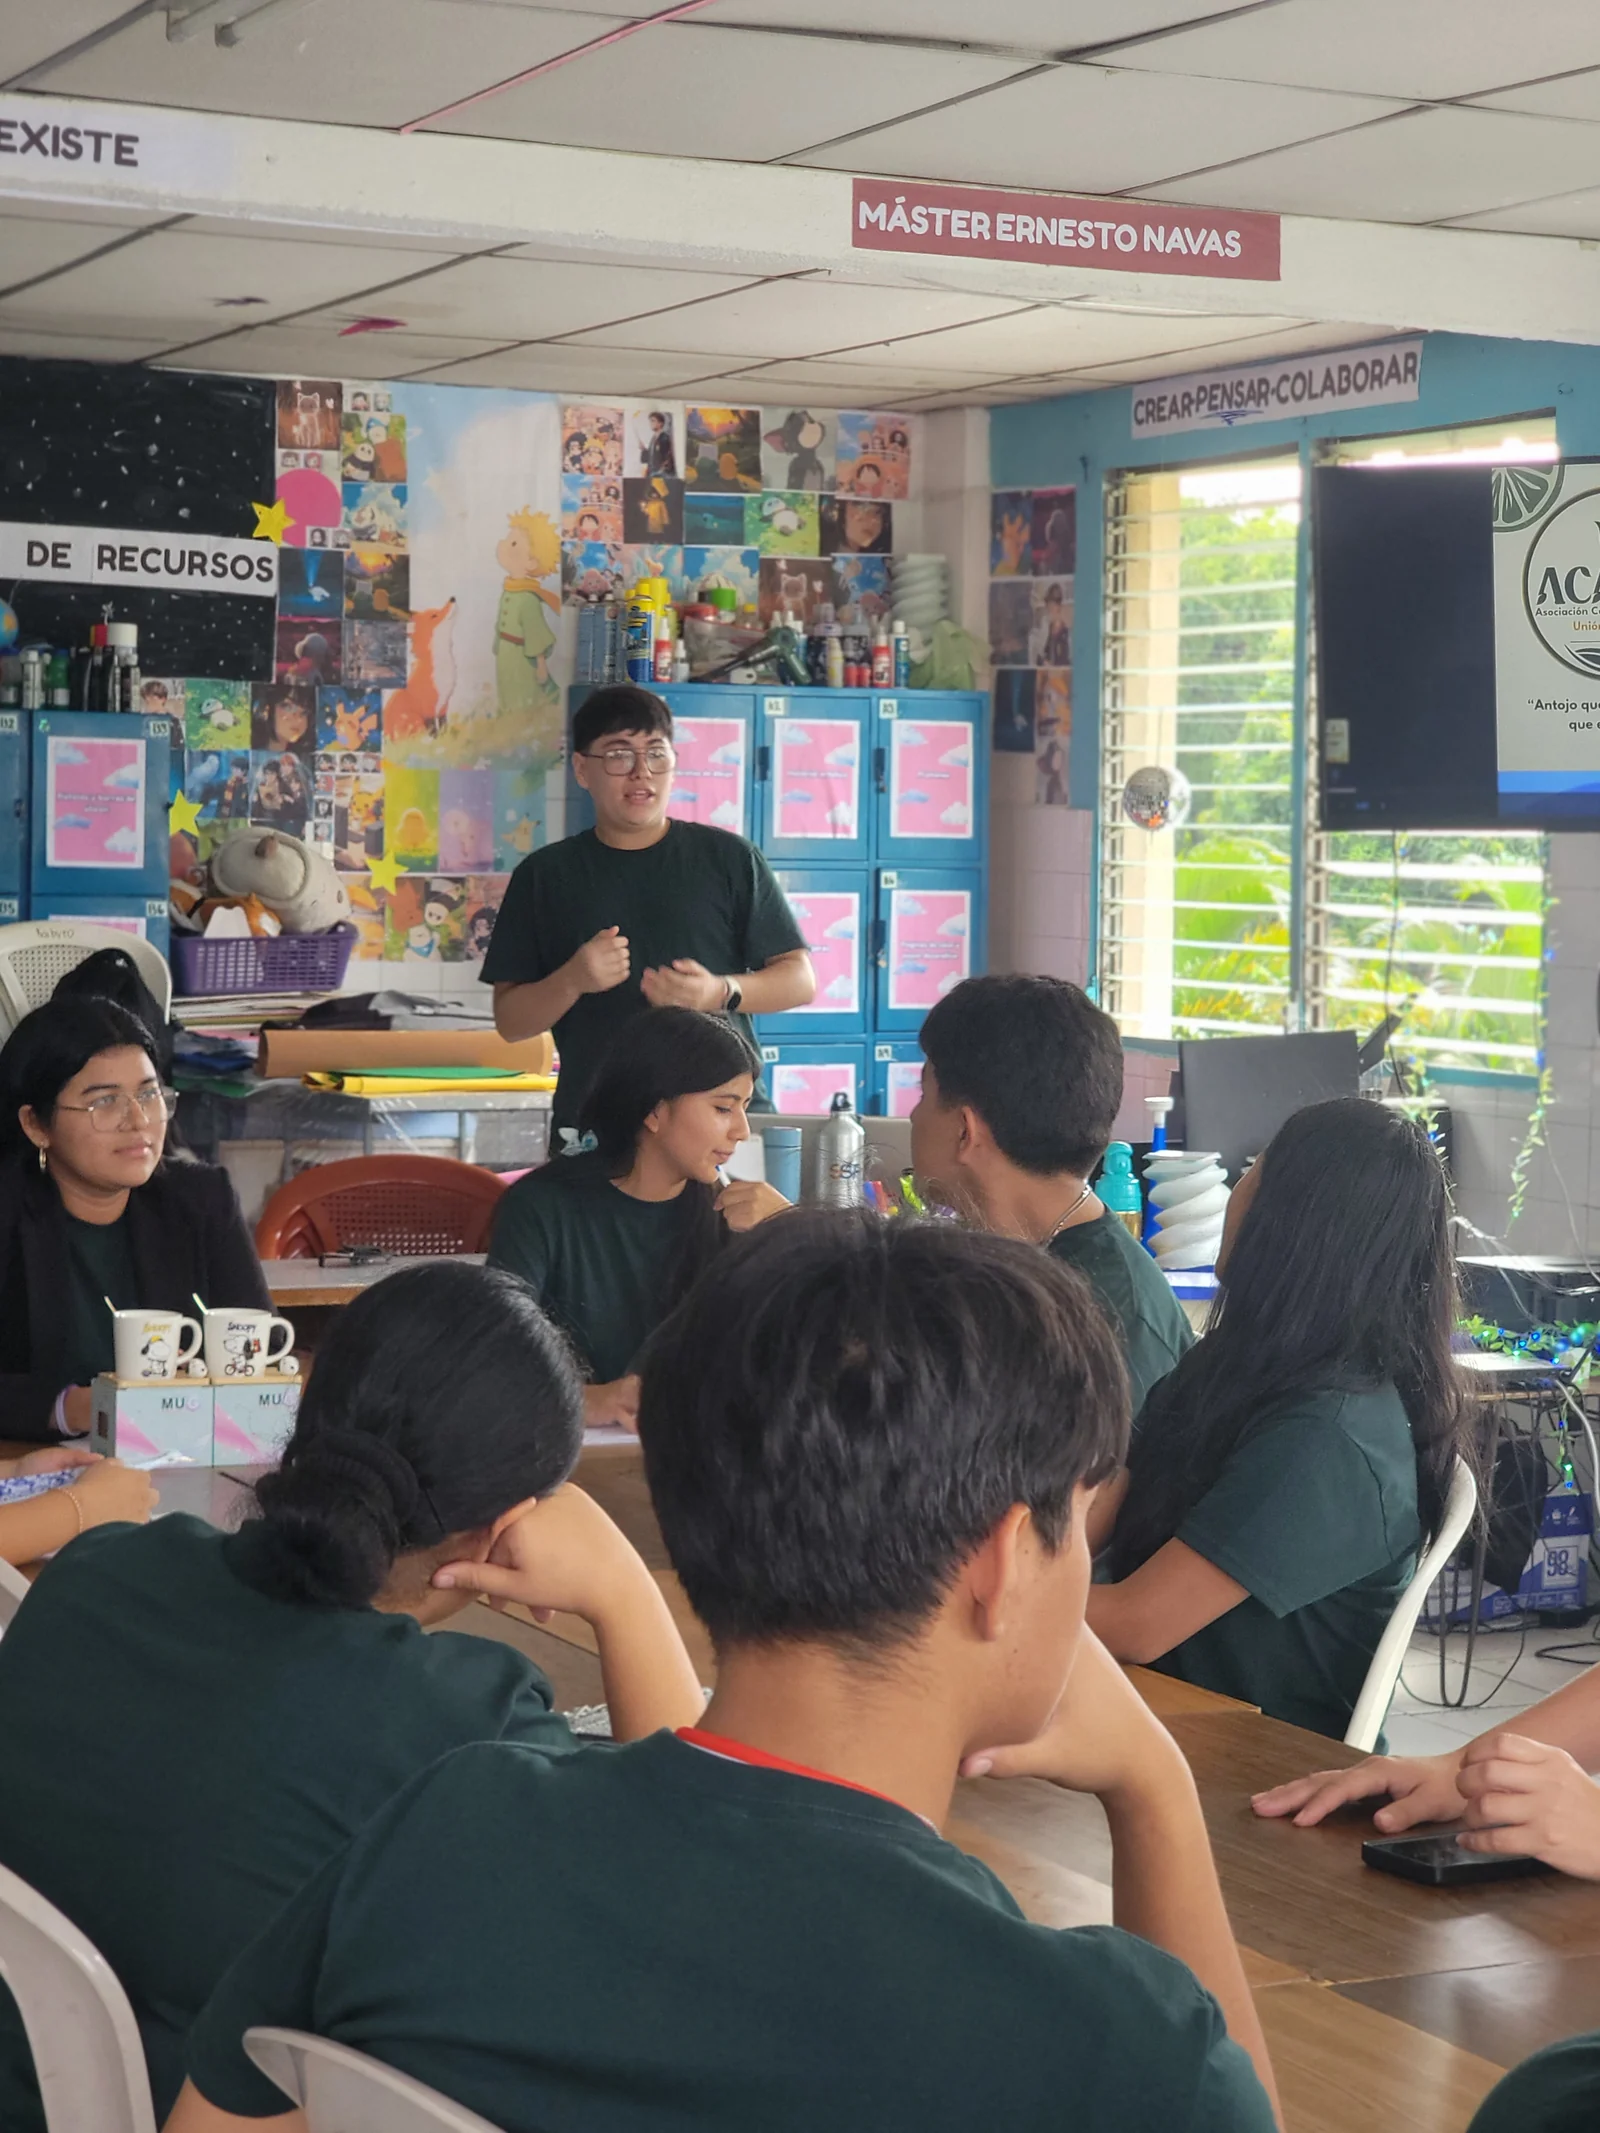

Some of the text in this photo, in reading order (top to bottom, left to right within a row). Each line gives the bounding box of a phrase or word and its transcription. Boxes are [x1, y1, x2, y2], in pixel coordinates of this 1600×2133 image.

[0, 119, 140, 168] EXISTE
[858, 196, 1242, 259] MÁSTER ERNESTO NAVAS
[27, 540, 275, 583] DE RECURSOS
[1535, 606, 1589, 617] Asociación
[1573, 620, 1600, 631] Unió
[1581, 702, 1600, 714] qu
[1569, 721, 1593, 733] que
[227, 1321, 257, 1333] SNOOPY
